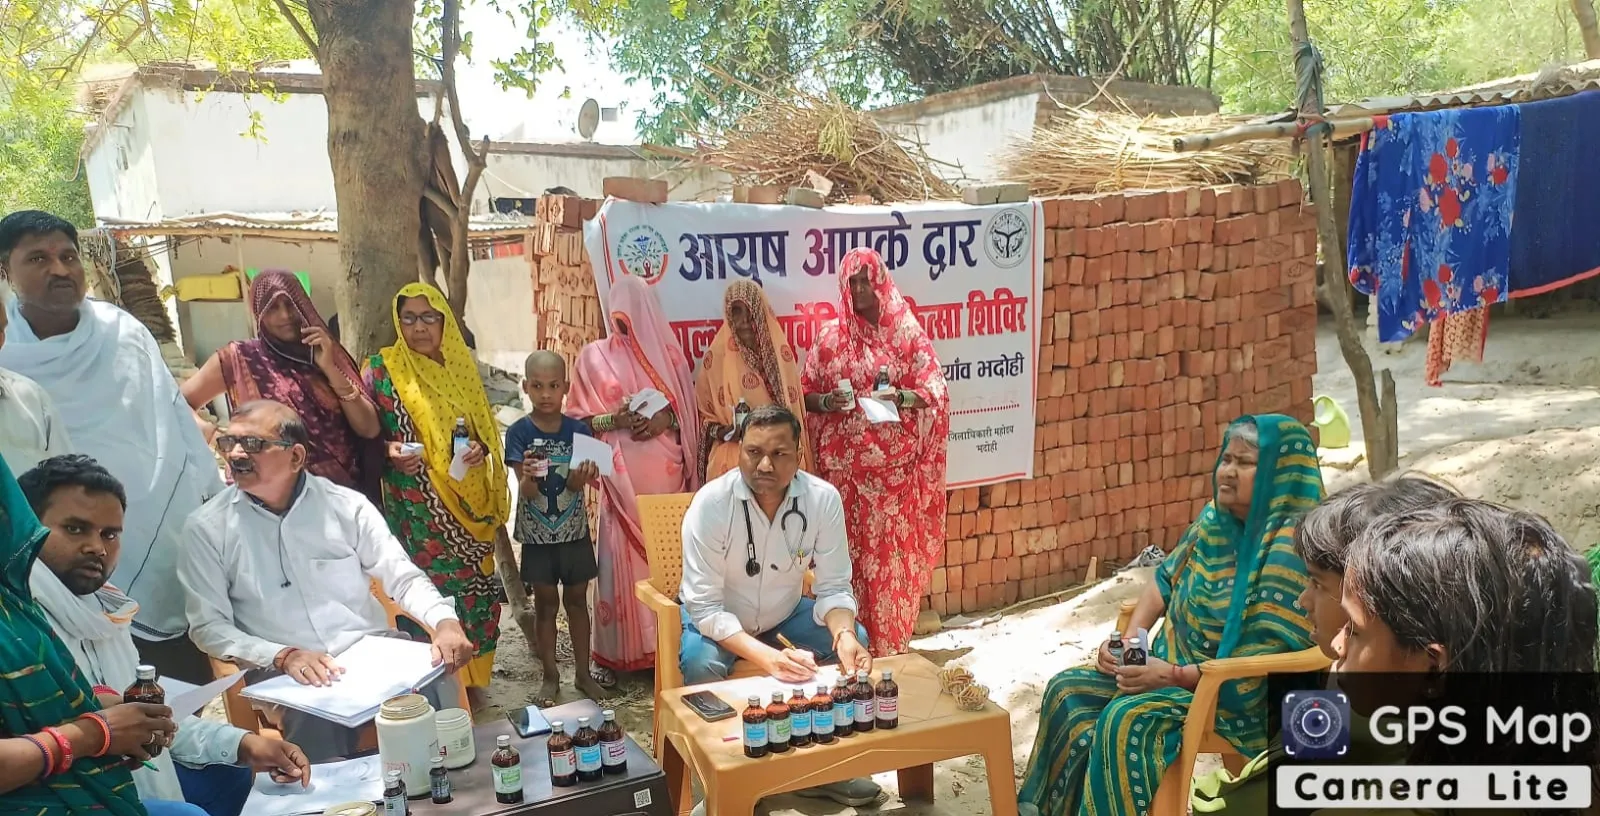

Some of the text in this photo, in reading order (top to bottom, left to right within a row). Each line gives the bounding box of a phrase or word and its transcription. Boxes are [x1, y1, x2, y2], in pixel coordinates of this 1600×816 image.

[679, 231, 789, 288] आयुष
[923, 220, 982, 281] द्वार
[967, 288, 1028, 336] शिविर
[977, 352, 1025, 378] भदोही
